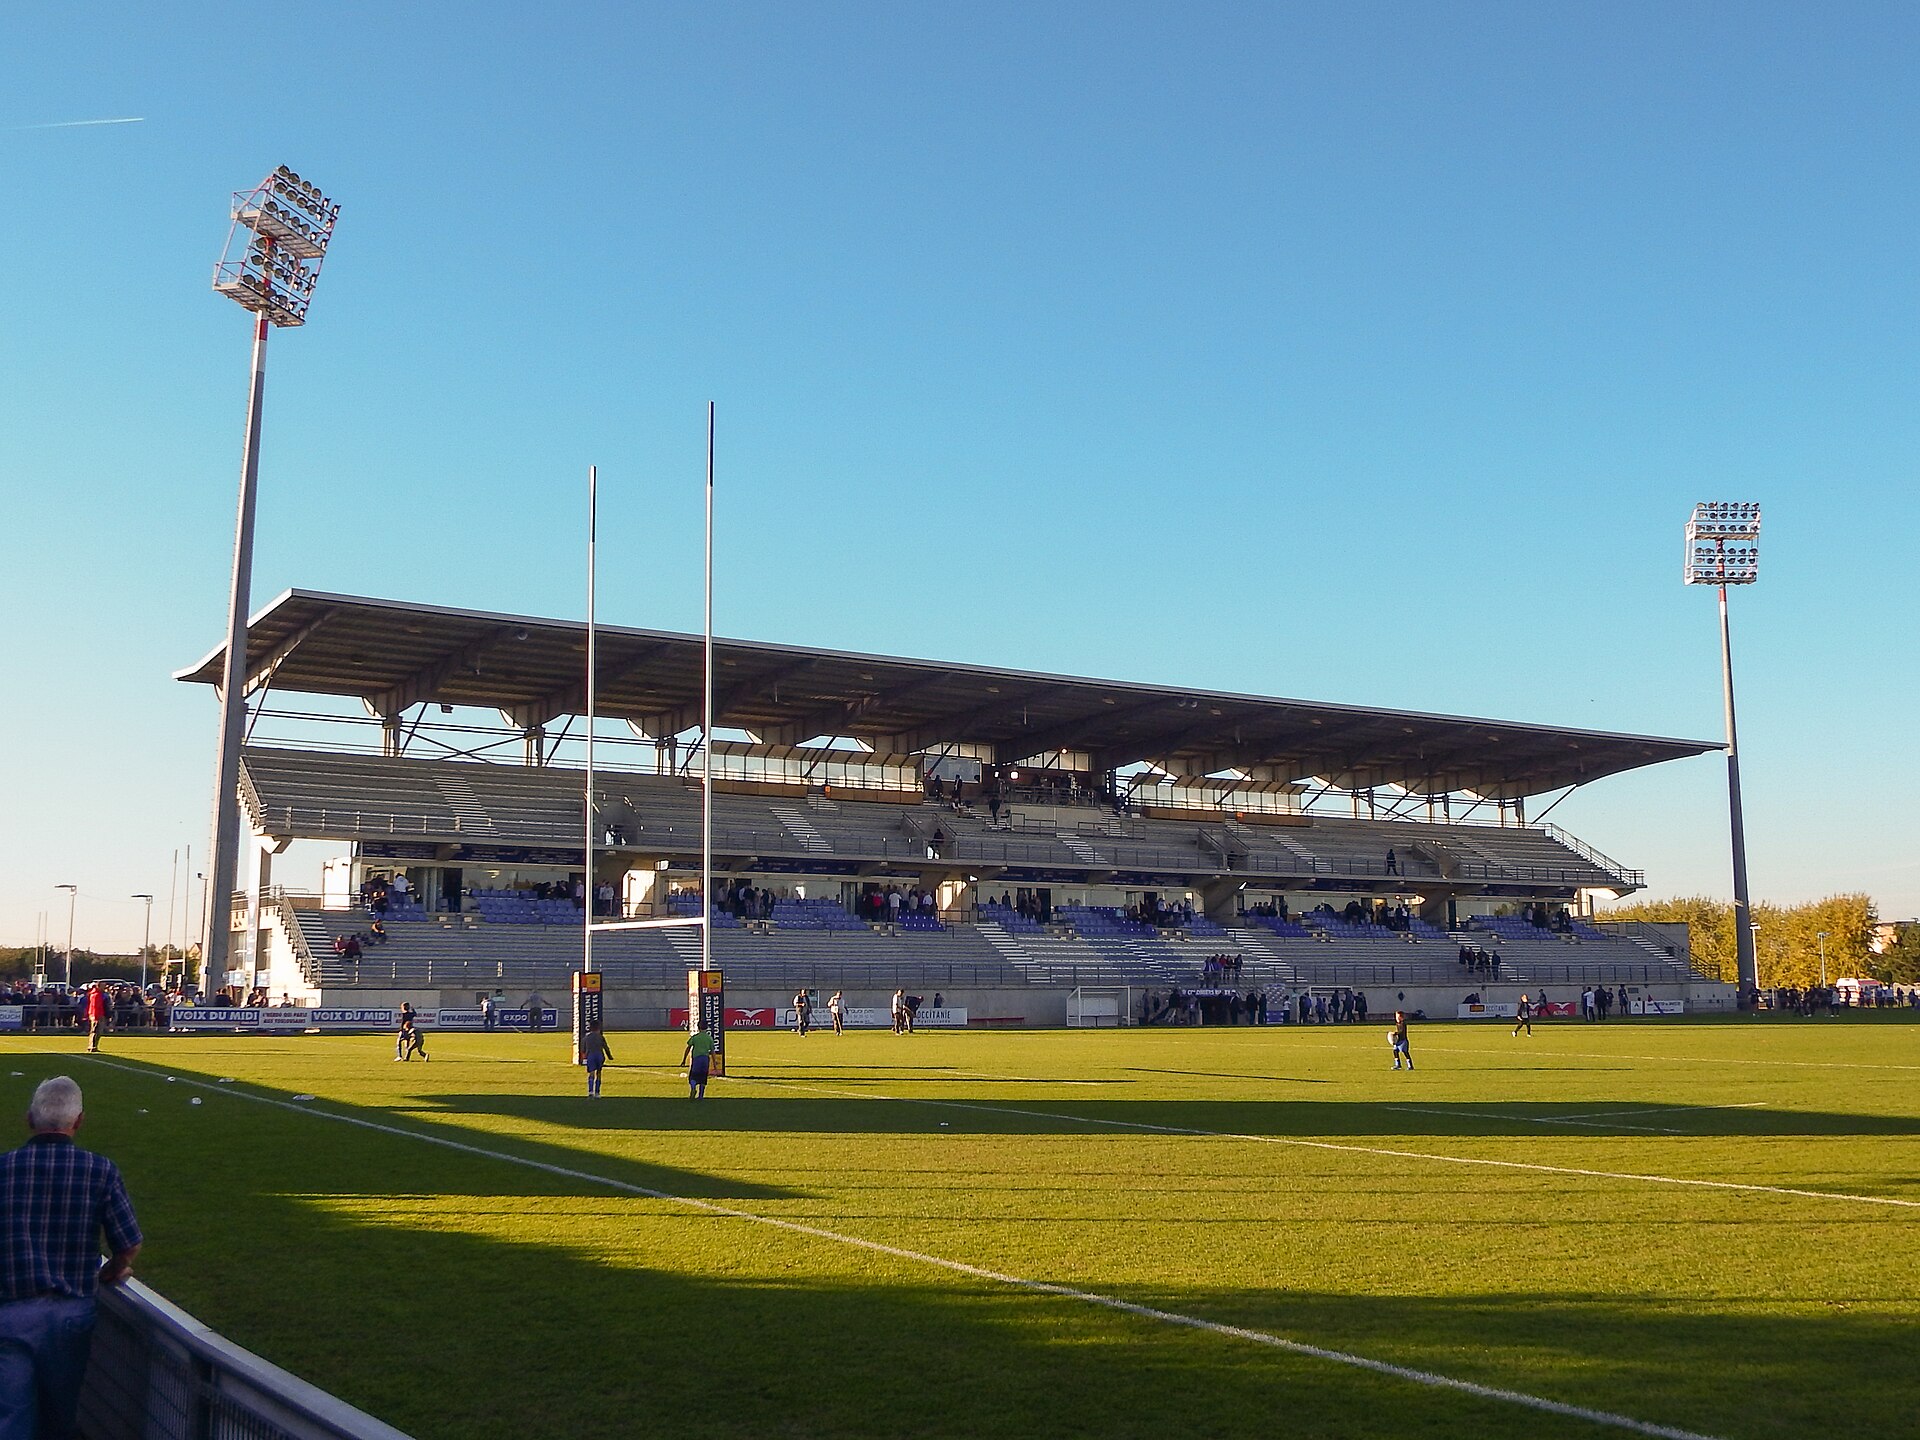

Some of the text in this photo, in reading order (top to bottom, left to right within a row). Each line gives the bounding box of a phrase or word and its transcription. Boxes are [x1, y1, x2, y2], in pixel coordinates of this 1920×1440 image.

[175, 1010, 258, 1021] VOIX DU MIDI
[313, 1011, 390, 1021] VOIX DU MIDI
[917, 1010, 950, 1019] OCCITANIE
